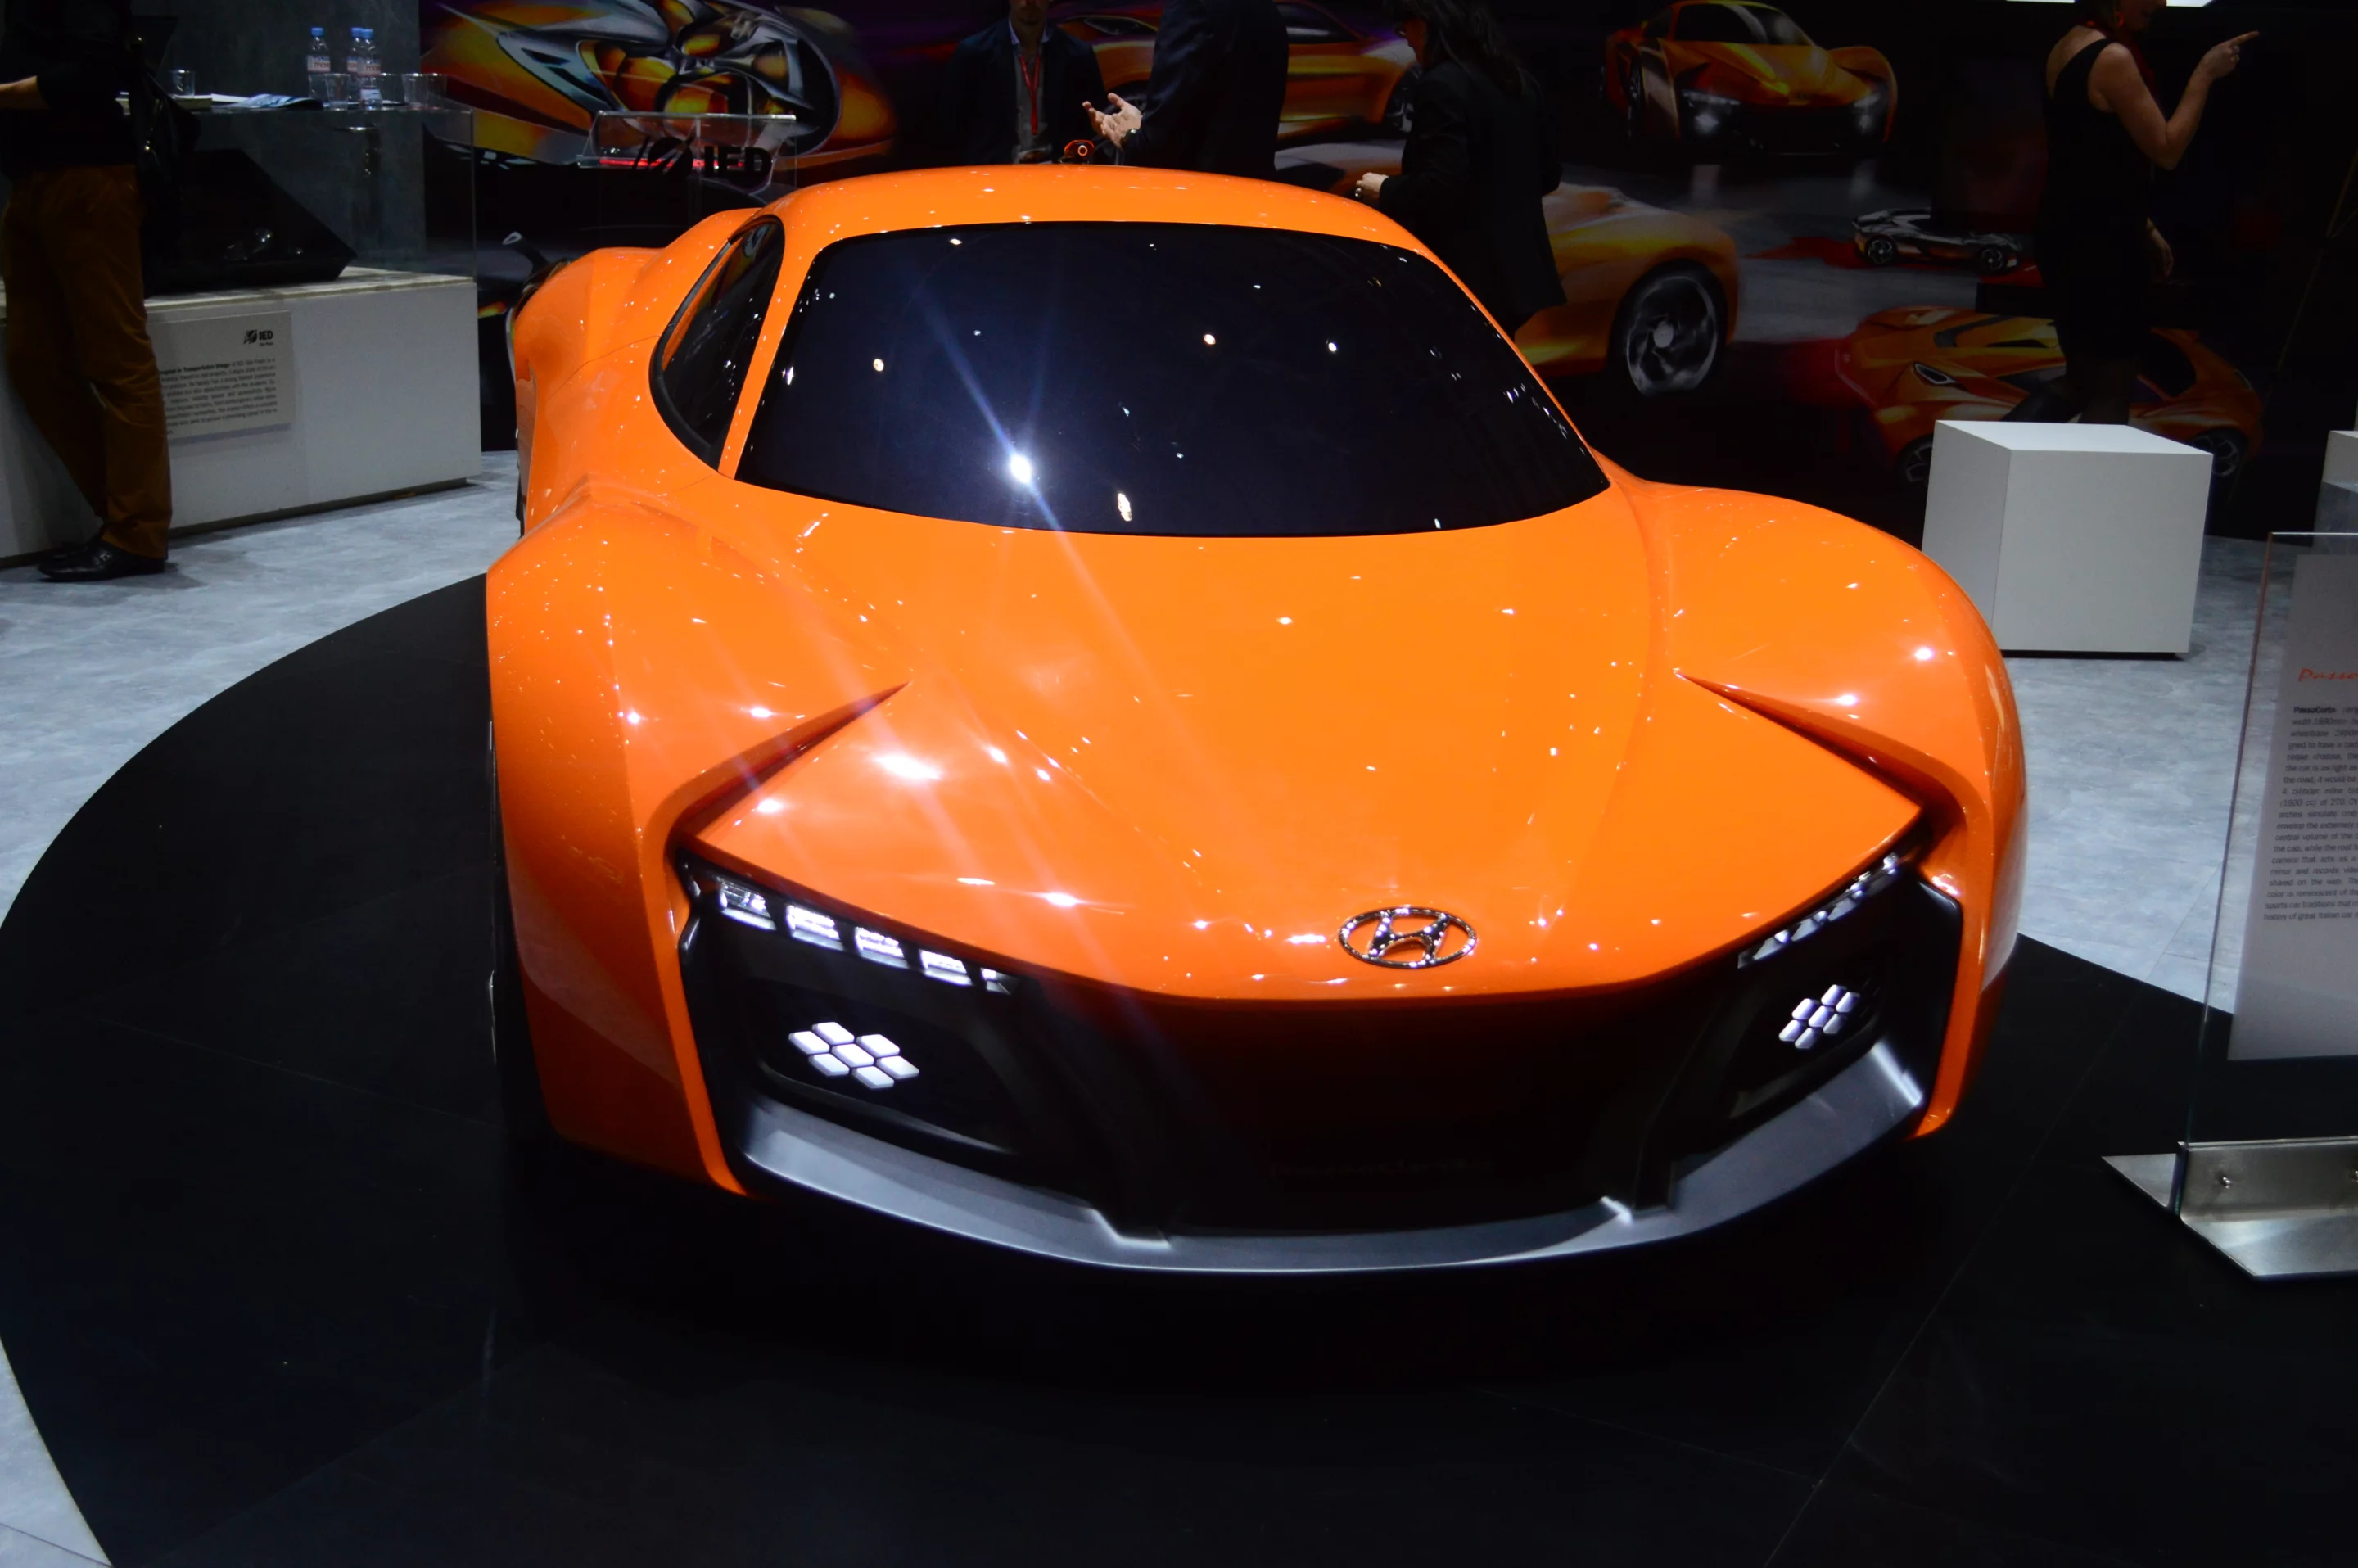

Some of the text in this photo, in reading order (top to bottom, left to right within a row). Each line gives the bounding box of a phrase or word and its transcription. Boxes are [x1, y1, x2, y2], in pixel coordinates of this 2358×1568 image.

[704, 146, 772, 175] IED
[259, 330, 273, 341] IED
[2293, 706, 2337, 714] PassoCorto
[2347, 775, 2357, 783] be
[2292, 787, 2320, 796] cylinder
[2279, 798, 2302, 807] (1600
[2320, 821, 2355, 830] extremely
[2302, 833, 2328, 841] volume
[2304, 844, 2323, 852] while
[2338, 843, 2352, 852] roof
[2269, 879, 2293, 887] shared
[2296, 889, 2338, 897] reminiscent
[2265, 901, 2288, 910] sports
[2302, 900, 2335, 908] traditions
[2264, 912, 2287, 920] history
[2297, 911, 2316, 921] great
